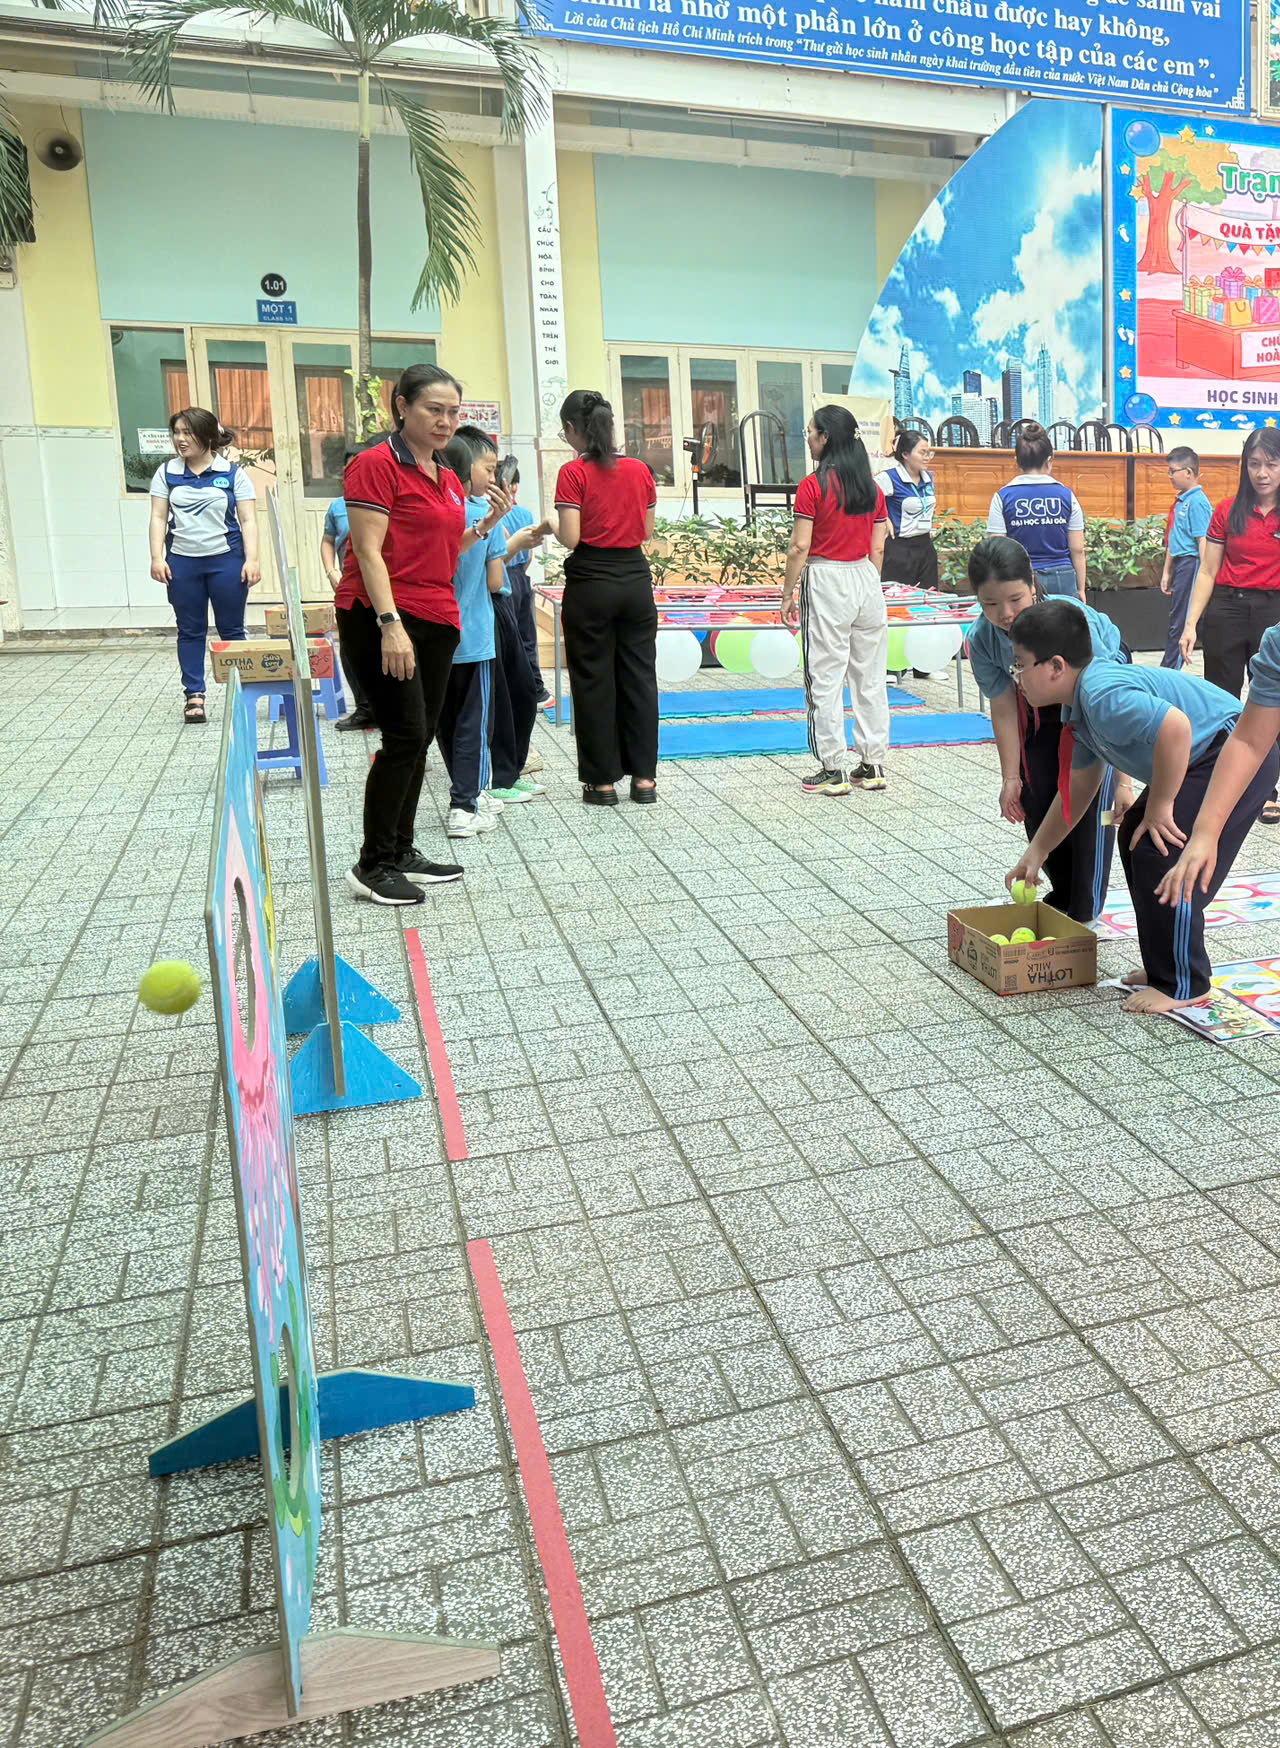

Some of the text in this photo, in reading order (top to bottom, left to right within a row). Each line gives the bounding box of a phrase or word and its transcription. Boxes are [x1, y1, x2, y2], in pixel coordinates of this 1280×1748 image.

[994, 1, 1048, 29] được
[1054, 8, 1093, 37] hay
[1099, 14, 1171, 47] không,
[737, 5, 788, 28] một
[795, 7, 857, 35] phần
[863, 15, 901, 41] lớn
[908, 19, 923, 43] ở
[929, 26, 984, 55] công
[990, 32, 1030, 58] học
[1037, 40, 1073, 69] tập
[1079, 43, 1117, 67] của
[1122, 50, 1159, 74] các
[564, 11, 1219, 99] Lời của Chủ tịch Hồ Chí Minh trích trong “Thư gửi học sinh nhân ngày khai trường đầu tiên của nước Việt Nam Dân chủ Cộng hòa”
[1220, 222, 1252, 240] QUÀ
[264, 280, 285, 291] 1.01
[262, 304, 293, 315] MỘT 1
[1207, 389, 1238, 408] HỌC
[1242, 390, 1278, 406] SINH
[1015, 498, 1061, 517] SGU
[1024, 519, 1039, 527] HỌC
[1041, 517, 1053, 525] SÀI
[220, 658, 254, 667] LOTHA
[1027, 962, 1051, 972] MILK
[1027, 967, 1073, 985] LOTHA
